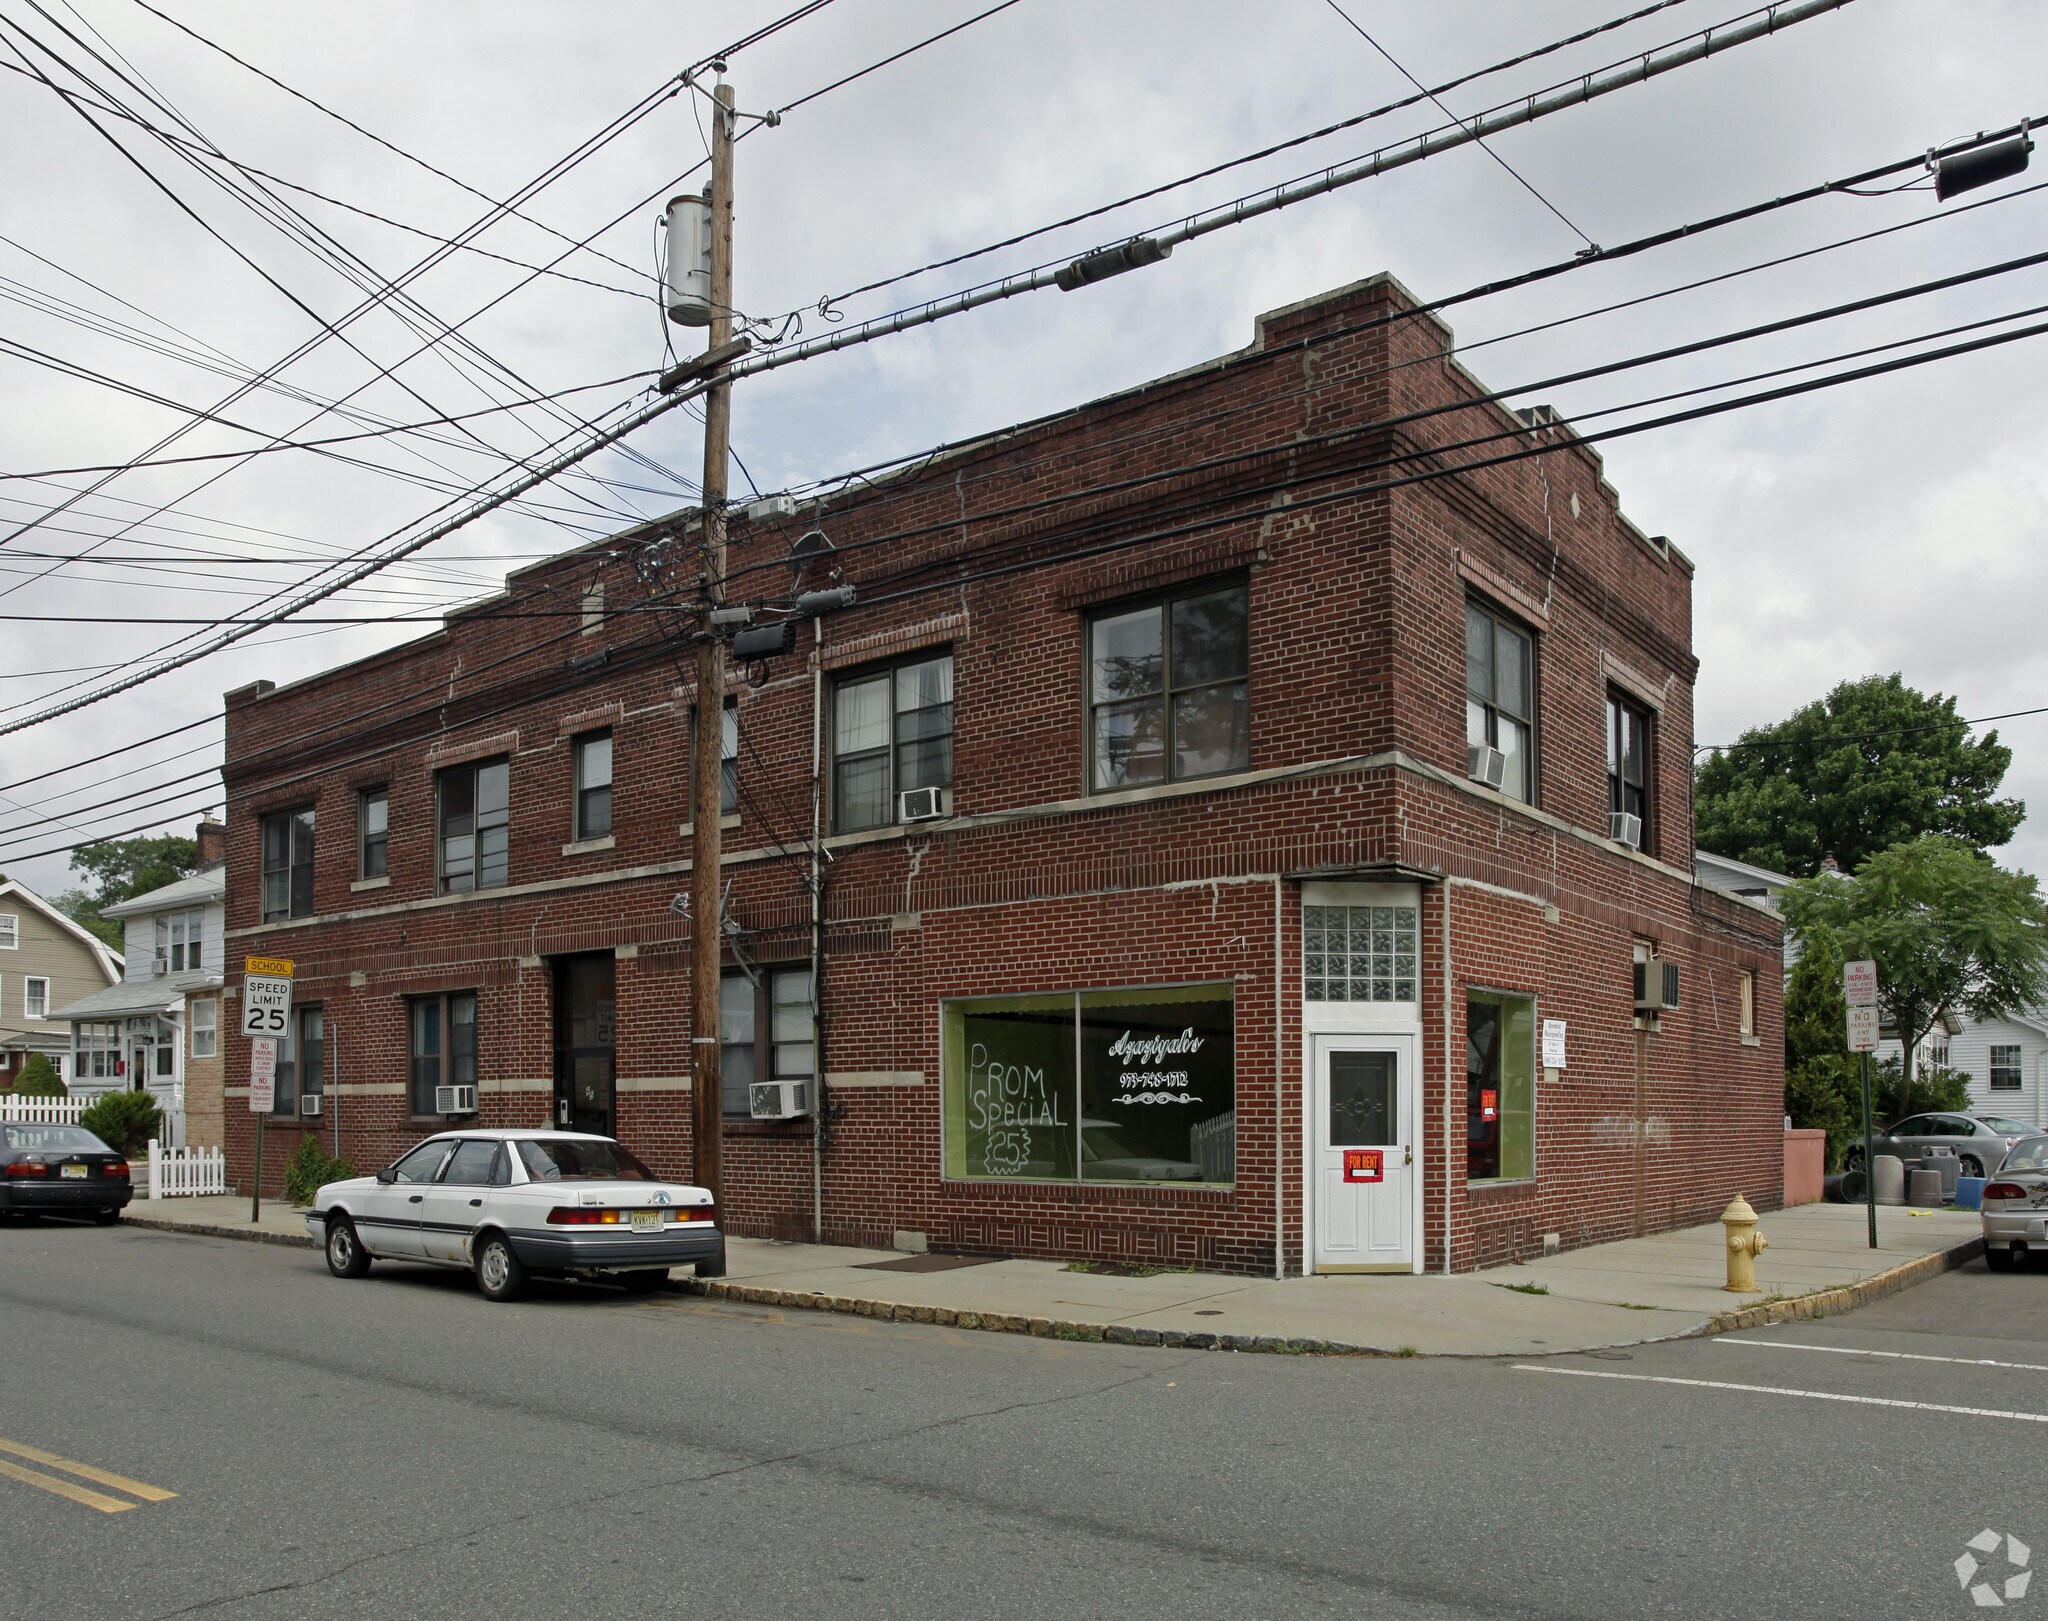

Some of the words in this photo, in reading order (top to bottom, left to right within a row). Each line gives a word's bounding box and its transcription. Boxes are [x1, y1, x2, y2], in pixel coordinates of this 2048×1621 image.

[251, 960, 287, 973] SCHOOL
[249, 982, 288, 994] SPEED
[252, 995, 283, 1006] LIMIT
[248, 1007, 285, 1031] 25
[1855, 1013, 1870, 1021] NO
[260, 1042, 270, 1050] NO
[969, 1043, 1046, 1102] PROM
[258, 1077, 268, 1085] NO
[1120, 1071, 1189, 1089] 973-748-1712
[992, 1131, 1020, 1166] 25
[1349, 1155, 1361, 1169] FOR
[1362, 1155, 1378, 1169] RENT
